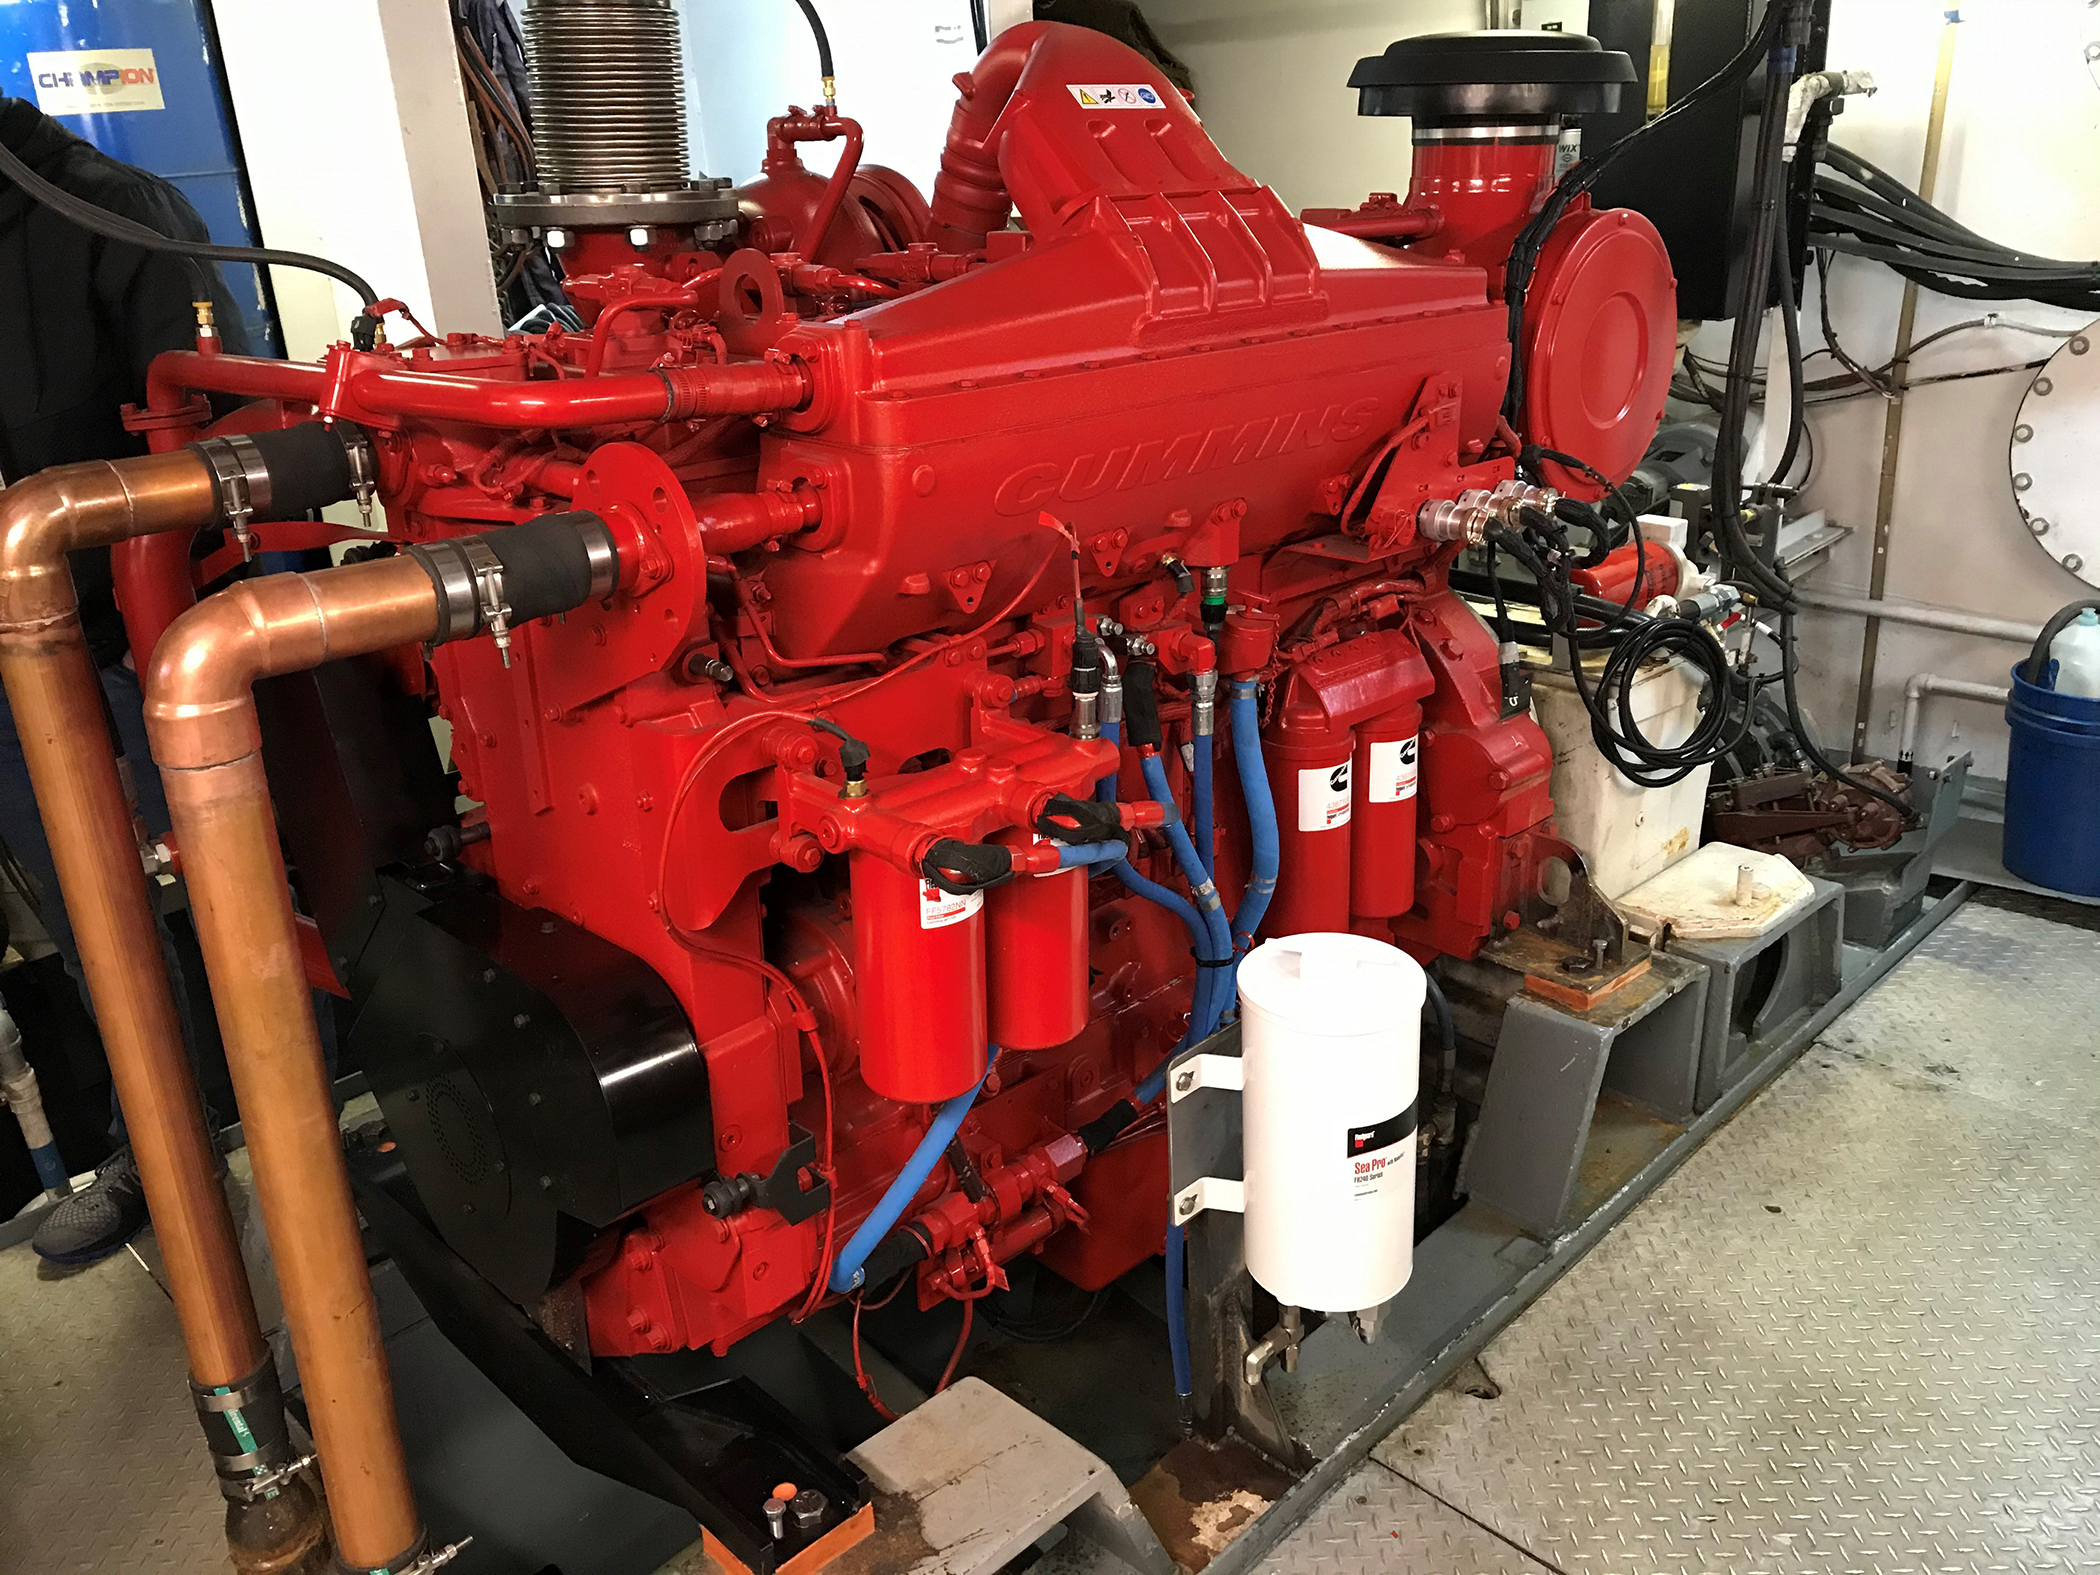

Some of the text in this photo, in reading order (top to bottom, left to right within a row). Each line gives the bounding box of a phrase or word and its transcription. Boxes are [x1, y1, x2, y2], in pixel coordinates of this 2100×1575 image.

[1558, 144, 1578, 153] WIX
[993, 397, 1379, 517] CUMMINS
[926, 899, 967, 915] FF5782NN
[1354, 1162, 1370, 1174] Sea
[1371, 1158, 1386, 1171] Pro
